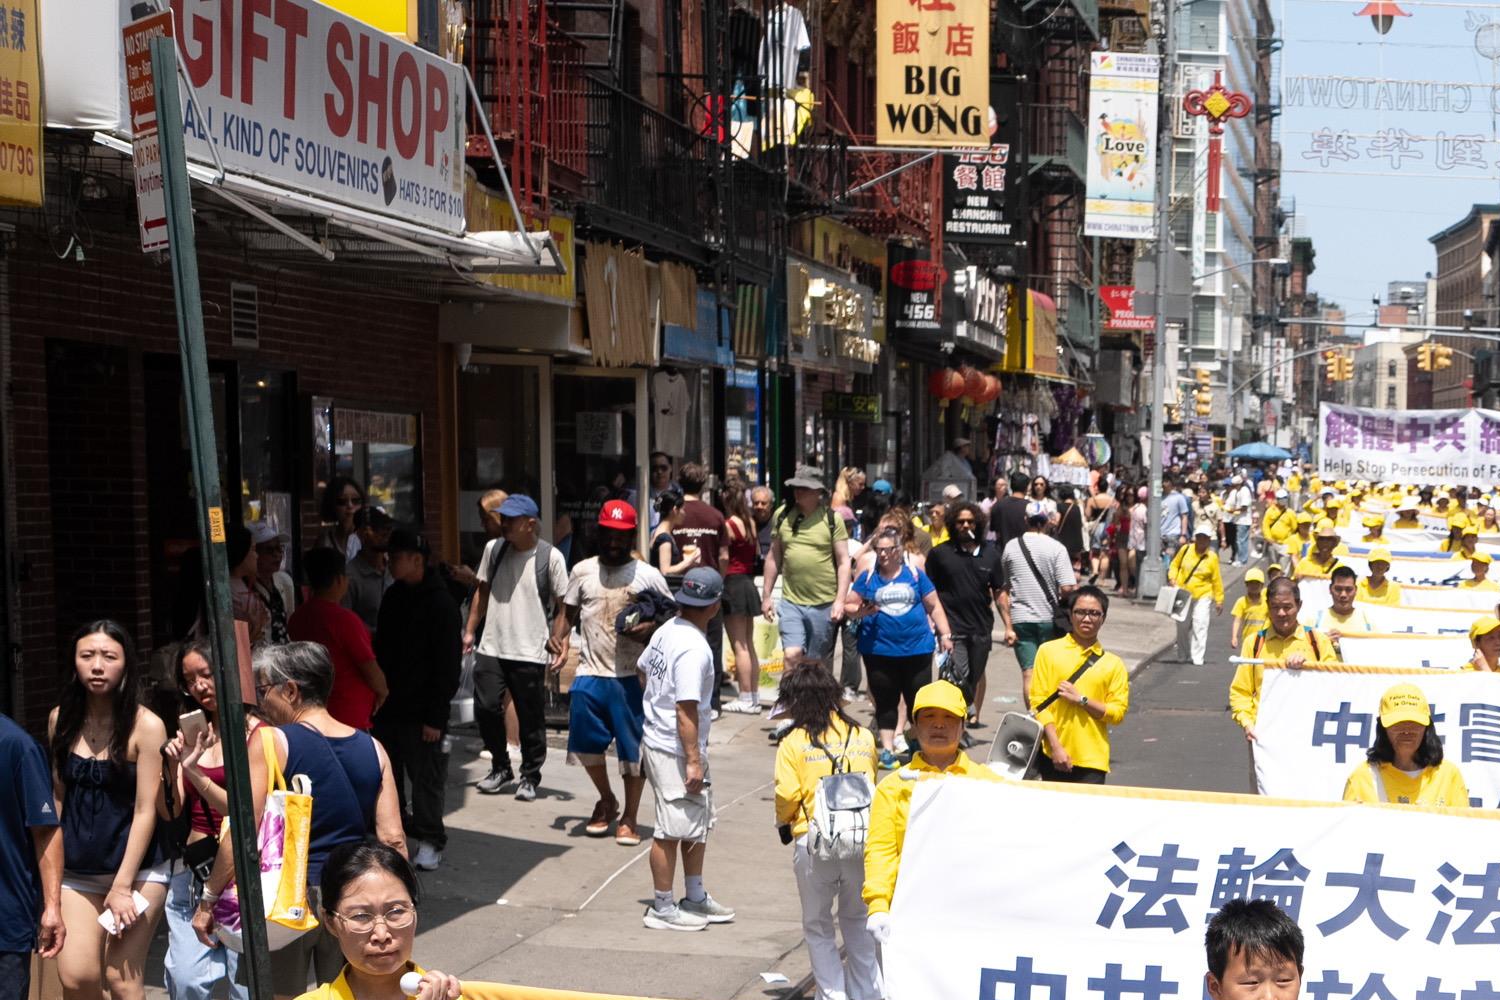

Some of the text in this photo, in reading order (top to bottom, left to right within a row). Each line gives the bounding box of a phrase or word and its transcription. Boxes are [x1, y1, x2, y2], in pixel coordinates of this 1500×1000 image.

[125, 35, 135, 57] NO
[892, 21, 974, 56] 飯店
[174, 0, 449, 166] GIFT SHOP
[905, 66, 961, 96] BIG
[886, 104, 981, 136] WONG
[184, 99, 379, 196] ALL KIND OF SOUVENIRS
[1104, 137, 1145, 152] Love
[953, 165, 1006, 191] 餐館
[400, 178, 420, 201] HATS
[430, 190, 446, 212] FOR
[448, 194, 462, 218] $10
[967, 196, 988, 207] NEW
[946, 223, 1012, 235] RESTAURANT
[911, 293, 928, 304] NEW
[904, 305, 934, 320] 456
[1111, 319, 1155, 328] PHARMACY
[1325, 411, 1465, 453] 解體中共
[1324, 459, 1352, 475] Help
[1357, 460, 1386, 477] Stop
[1391, 462, 1469, 478] Persecution
[1472, 464, 1485, 478] of
[805, 755, 828, 763] FALUN
[294, 815, 309, 905] worldwildlife.org
